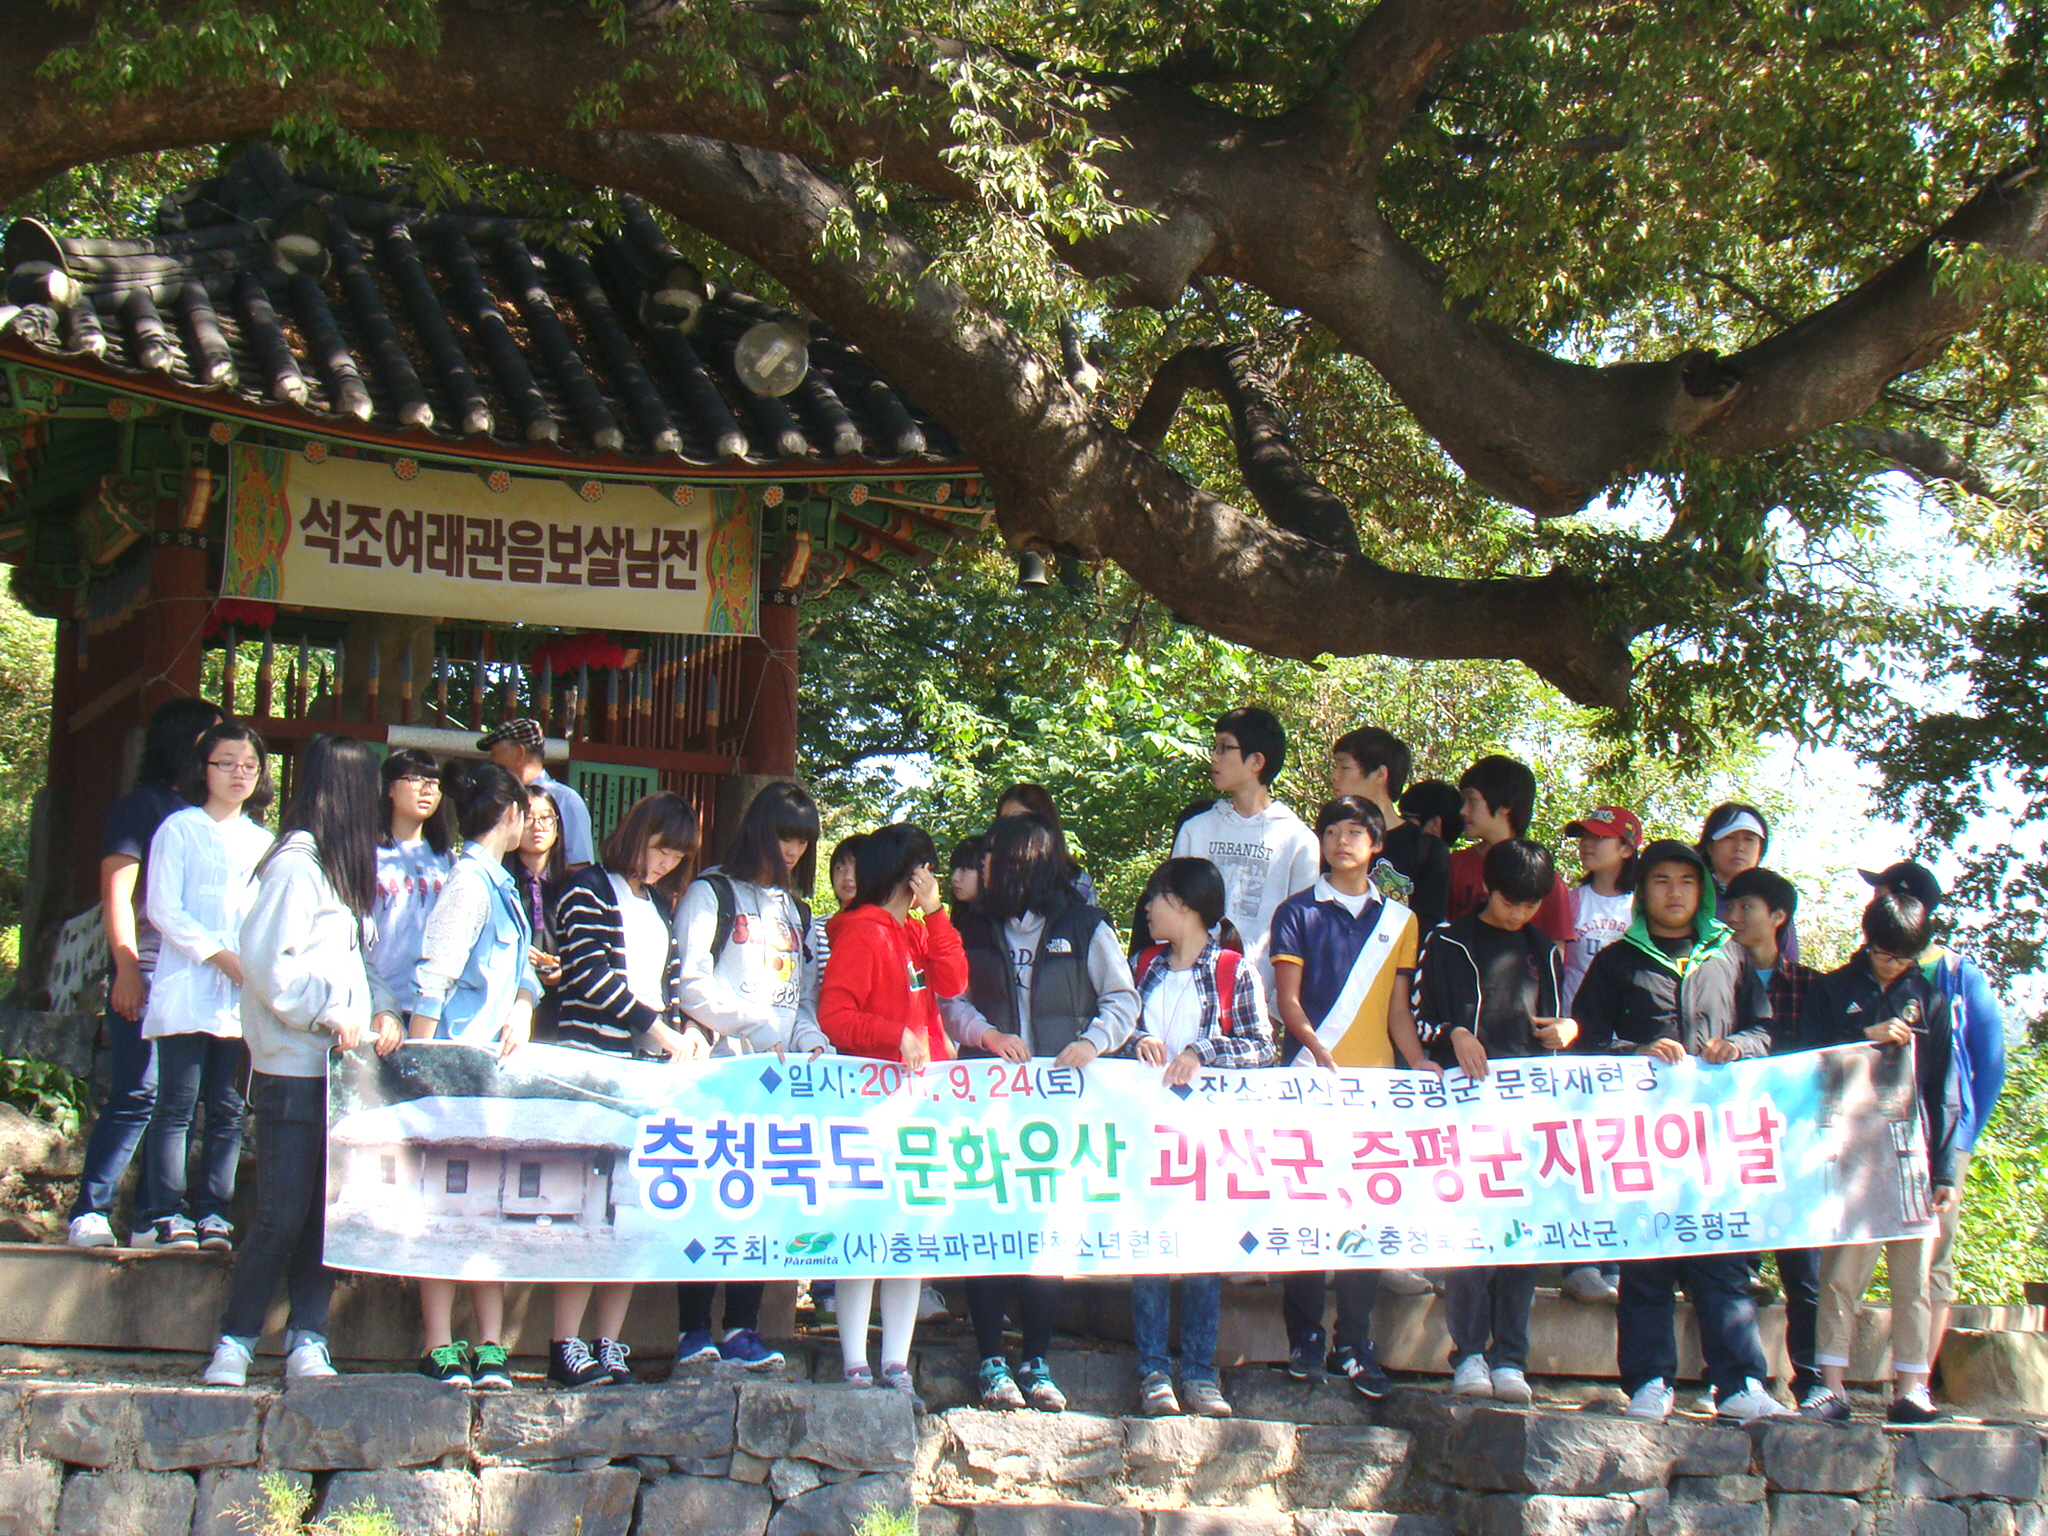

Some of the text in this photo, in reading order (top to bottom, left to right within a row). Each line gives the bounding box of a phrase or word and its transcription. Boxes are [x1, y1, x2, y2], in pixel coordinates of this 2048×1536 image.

[299, 497, 699, 591] 석조여래관음보살님전
[1208, 841, 1274, 861] URBANIST
[637, 1117, 884, 1209] 충청북도
[895, 1121, 1127, 1206] 문화유산
[1673, 1210, 1751, 1243] 증평군
